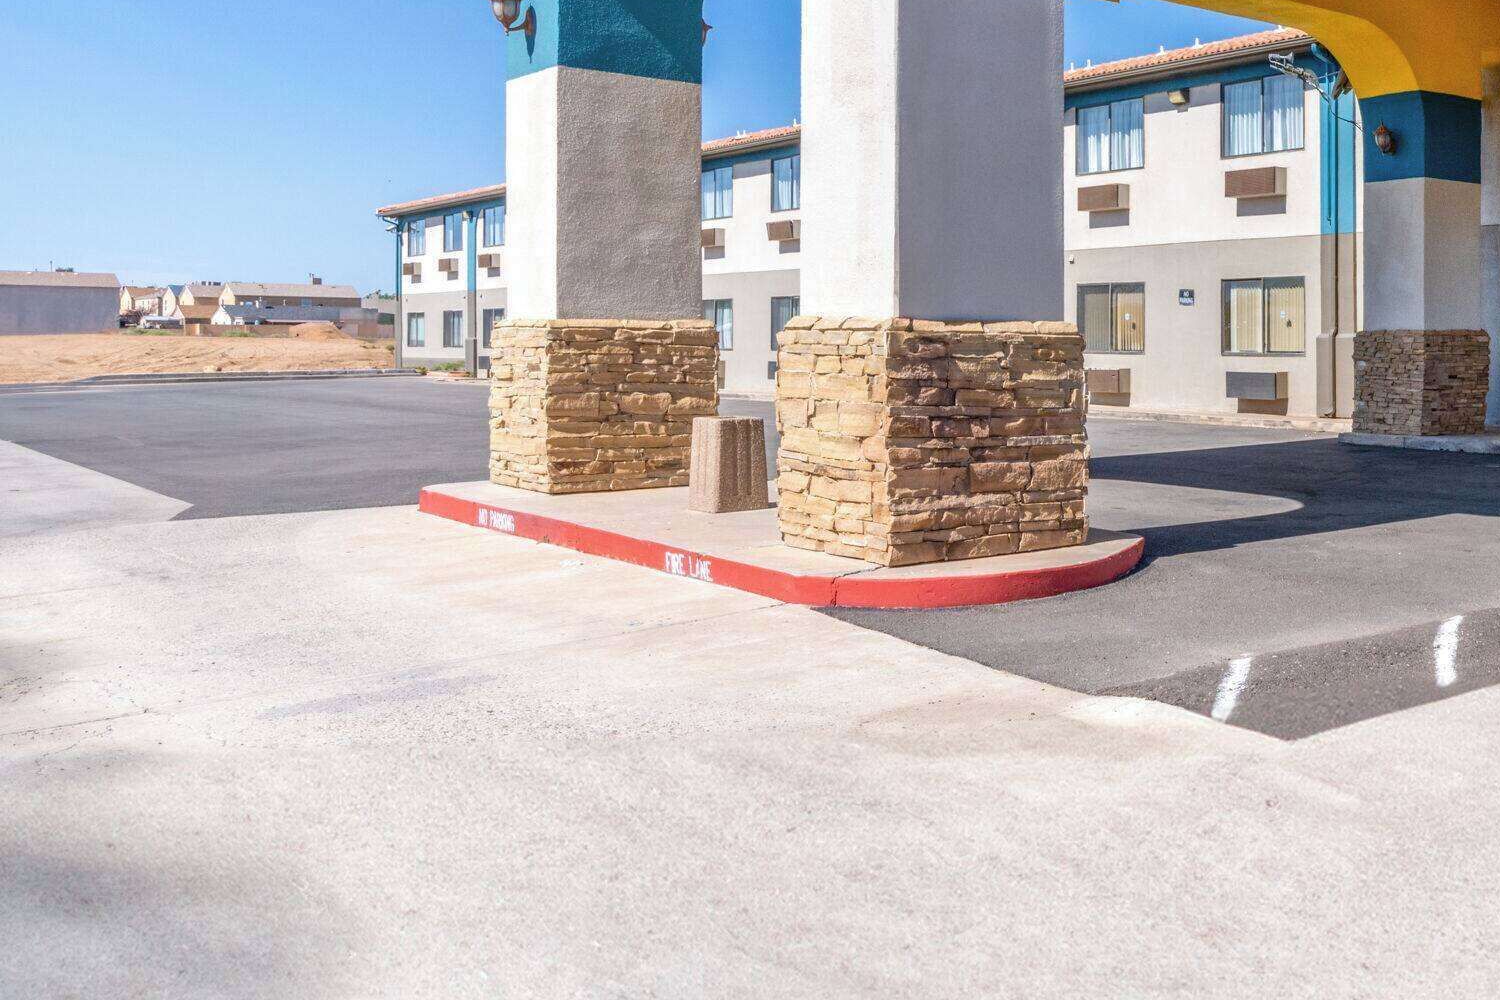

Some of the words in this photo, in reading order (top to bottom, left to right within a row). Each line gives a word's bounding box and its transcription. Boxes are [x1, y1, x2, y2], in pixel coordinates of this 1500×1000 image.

[478, 508, 488, 525] NO
[490, 510, 515, 532] PARKING
[665, 551, 685, 575] FIRE
[689, 556, 713, 581] LANE
